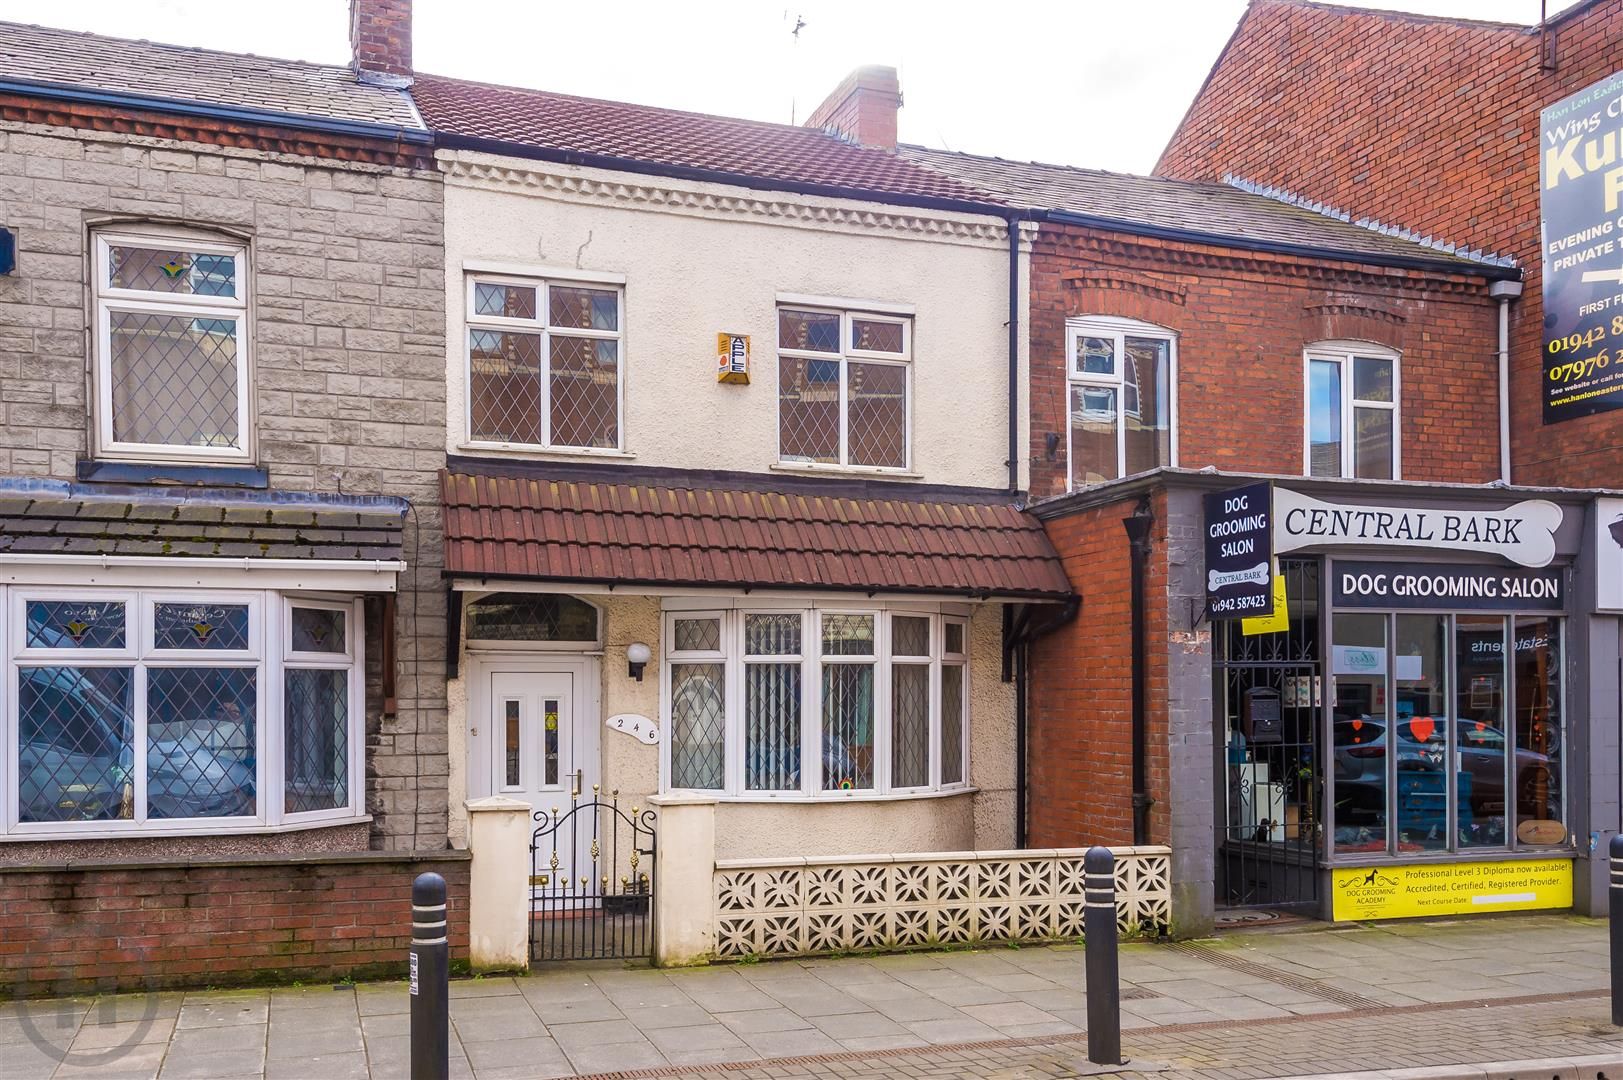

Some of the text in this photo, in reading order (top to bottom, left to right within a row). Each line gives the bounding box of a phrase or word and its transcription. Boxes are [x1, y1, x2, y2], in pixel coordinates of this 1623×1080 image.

[1546, 95, 1623, 145] Wing C
[1547, 107, 1568, 122] Han
[1546, 127, 1623, 190] Ku
[1549, 221, 1613, 254] EVENING
[1553, 240, 1614, 272] PRIVATE
[1579, 294, 1623, 316] FIRST F
[1548, 326, 1605, 354] 01942
[731, 336, 745, 373] APPLE
[1549, 348, 1609, 383] 07976
[1564, 381, 1590, 392] website
[1224, 495, 1249, 514] DOG
[1209, 513, 1266, 538] GROOMING
[1285, 508, 1523, 544] CENTRAL BARK
[1221, 538, 1254, 558] SALON
[1214, 570, 1261, 584] CENTRAL BARK
[1342, 573, 1558, 598] DOG GROOMING SALON
[1212, 594, 1266, 612] 01942 587423
[1405, 869, 1452, 879] Professional
[1454, 868, 1474, 877] Level
[1476, 867, 1481, 876] 3
[1483, 866, 1514, 876] Diploma
[1362, 888, 1396, 896] GROOMING
[1488, 879, 1528, 890] Registered
